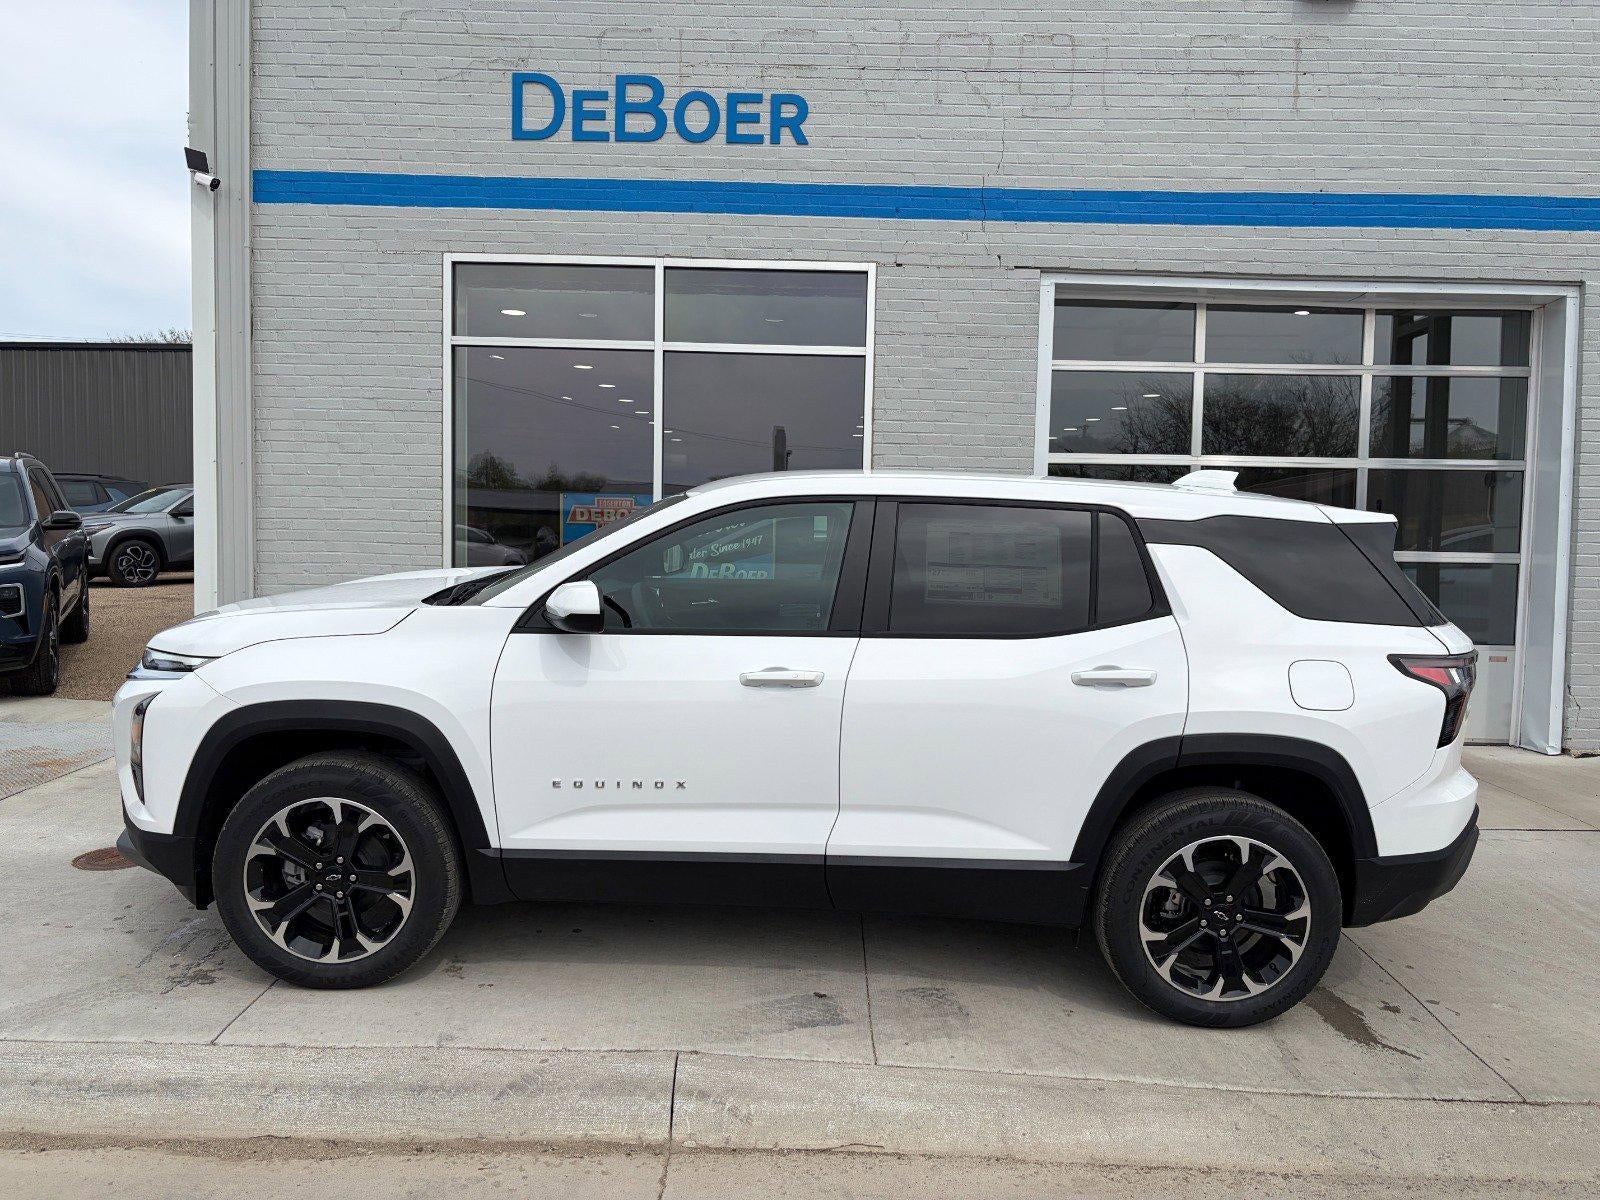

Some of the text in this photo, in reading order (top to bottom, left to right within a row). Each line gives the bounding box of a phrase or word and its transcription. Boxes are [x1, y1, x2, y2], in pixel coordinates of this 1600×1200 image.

[575, 508, 637, 521] DEBO
[710, 542, 741, 557] Since
[552, 780, 687, 789] EQUINOX
